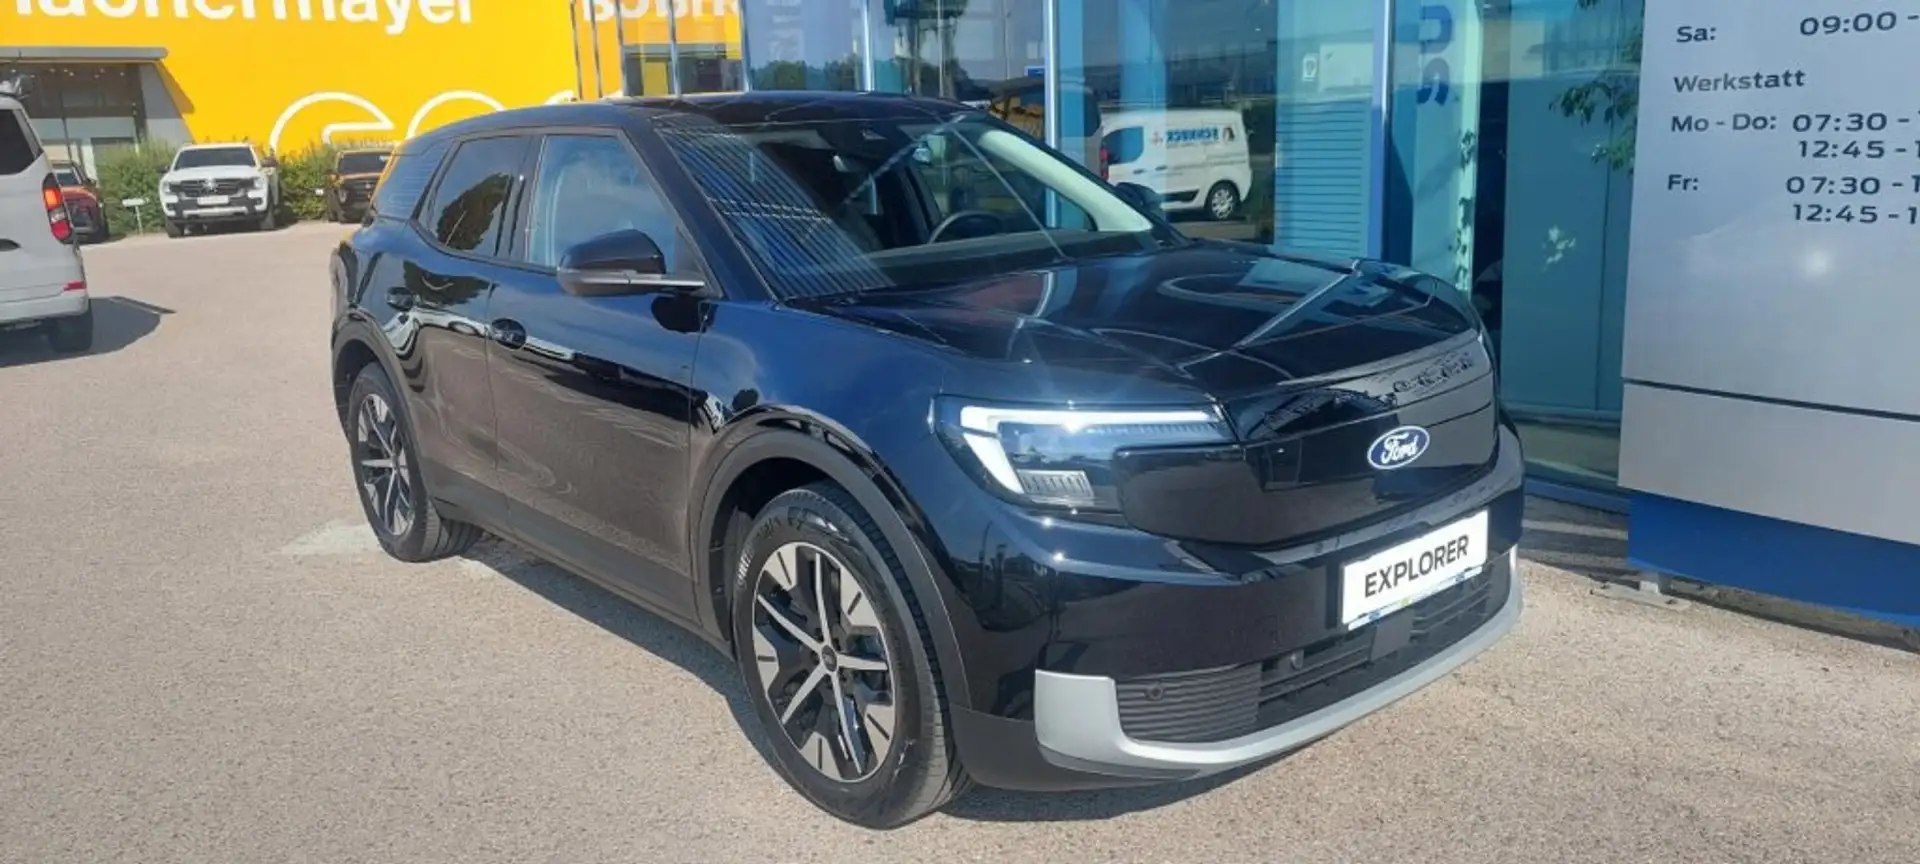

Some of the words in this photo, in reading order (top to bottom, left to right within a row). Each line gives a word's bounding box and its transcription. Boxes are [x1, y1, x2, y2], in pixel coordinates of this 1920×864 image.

[1675, 25, 1717, 43] Sa:
[1799, 11, 1897, 36] 09:00
[1673, 69, 1806, 93] Werkstatt
[1671, 115, 1710, 132] Mo
[1732, 113, 1778, 131] Do:
[1792, 112, 1888, 133] 07:30
[1798, 140, 1886, 159] 12:45
[1666, 173, 1700, 191] Fr:
[1785, 176, 1881, 195] 07:30
[1792, 203, 1879, 224] 12:45
[1379, 432, 1419, 465] Ford
[1364, 533, 1470, 598] EXPLORER
